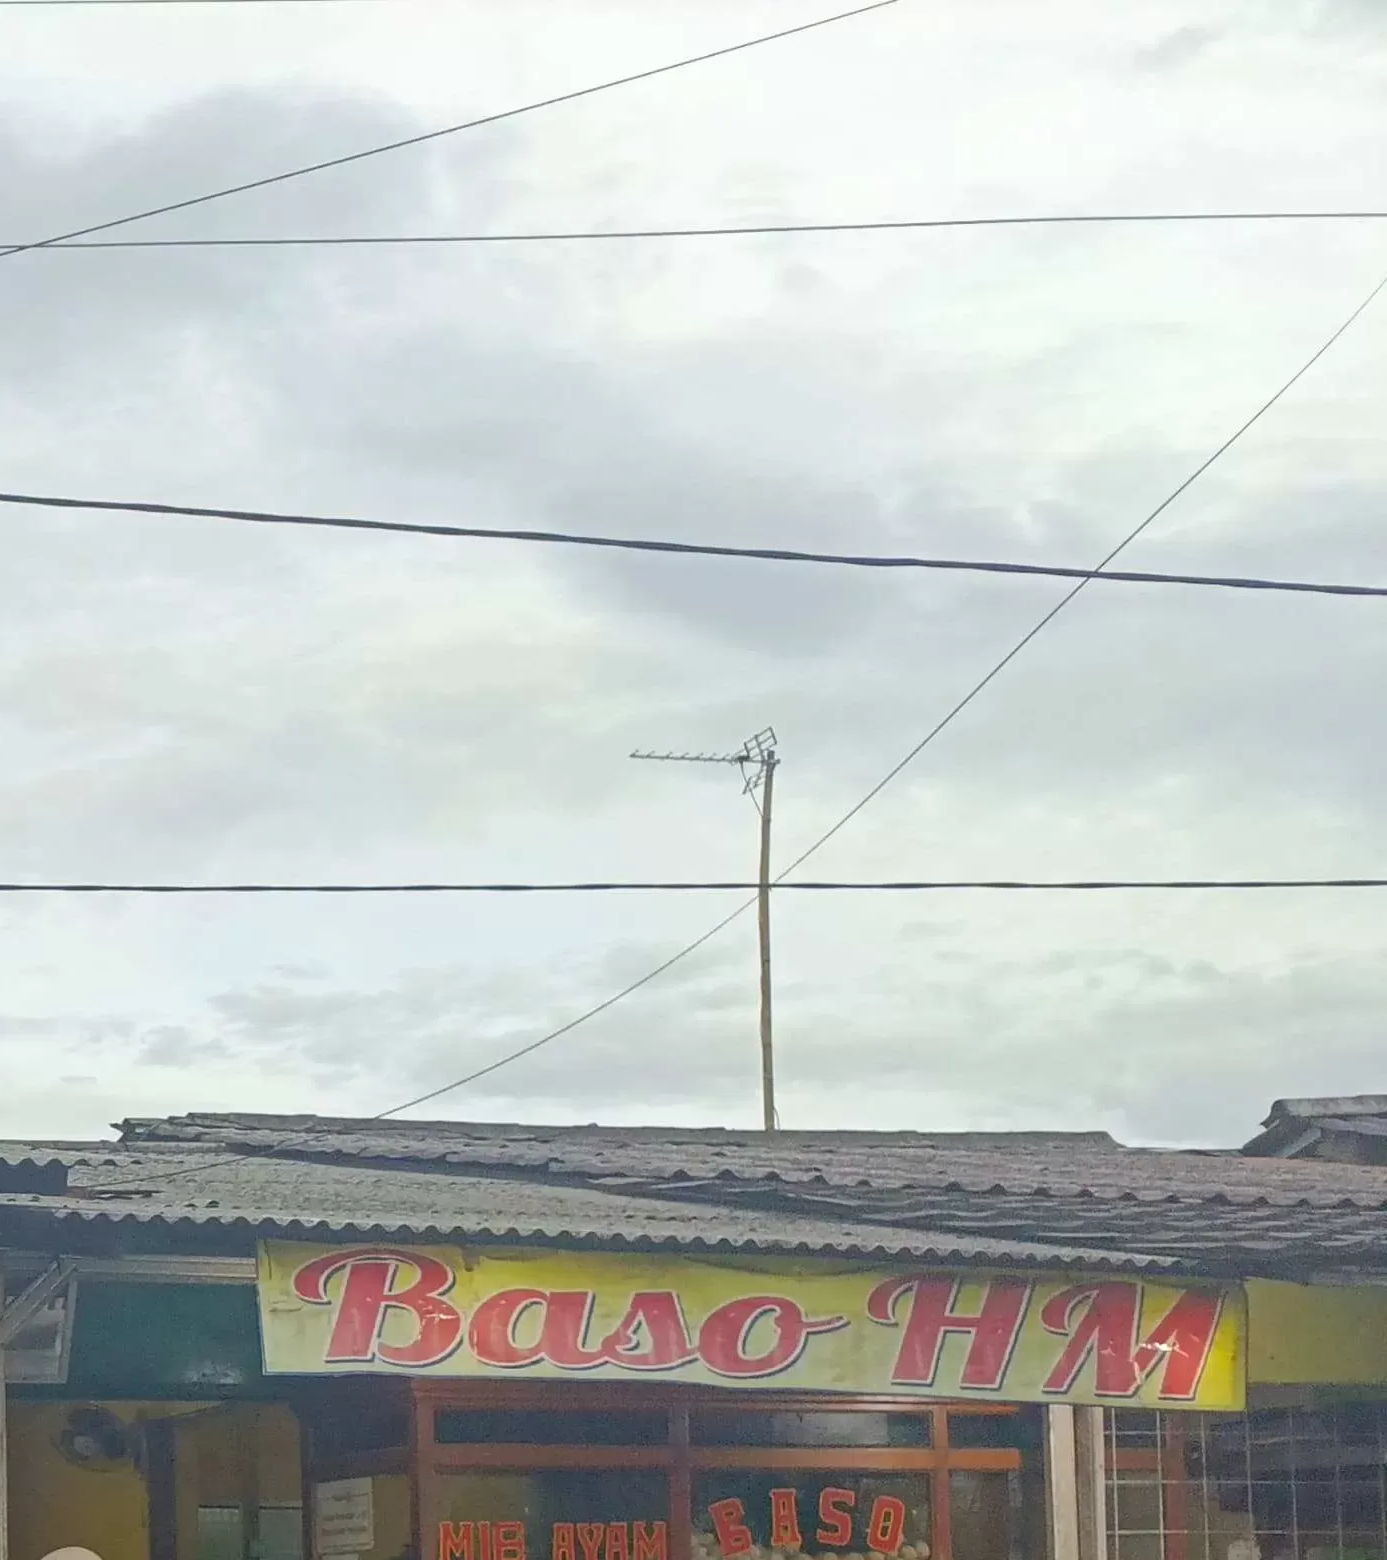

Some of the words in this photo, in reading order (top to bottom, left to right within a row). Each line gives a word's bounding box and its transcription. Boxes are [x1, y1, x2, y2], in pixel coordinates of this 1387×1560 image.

[293, 1247, 849, 1380] Baso
[866, 1272, 1227, 1400] HM
[708, 1487, 906, 1558] BASO
